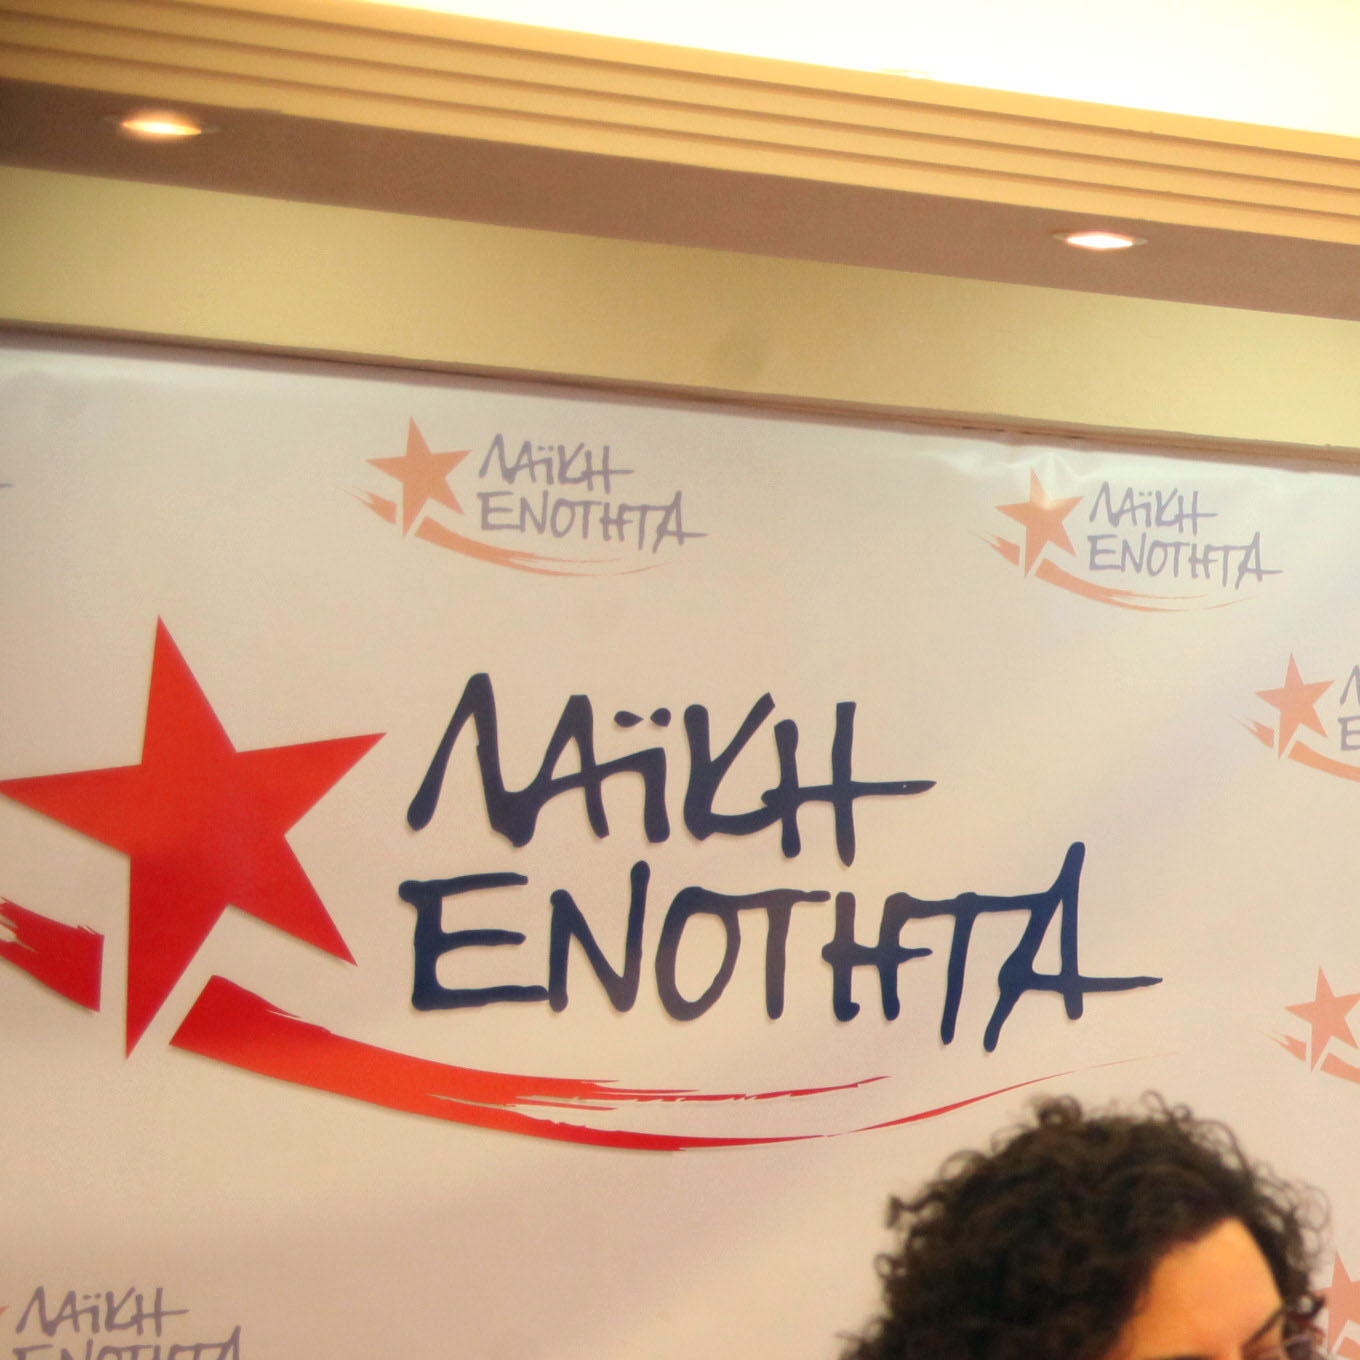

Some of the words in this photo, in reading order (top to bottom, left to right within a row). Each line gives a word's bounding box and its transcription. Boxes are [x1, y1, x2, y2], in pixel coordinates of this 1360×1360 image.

[475, 489, 708, 553] ΕΝΟΤΗΤΑ
[1086, 532, 1285, 590] ΕΝΟΤΗΤΑ
[394, 839, 1165, 1057] ΕΝΟΤΗΤΑ
